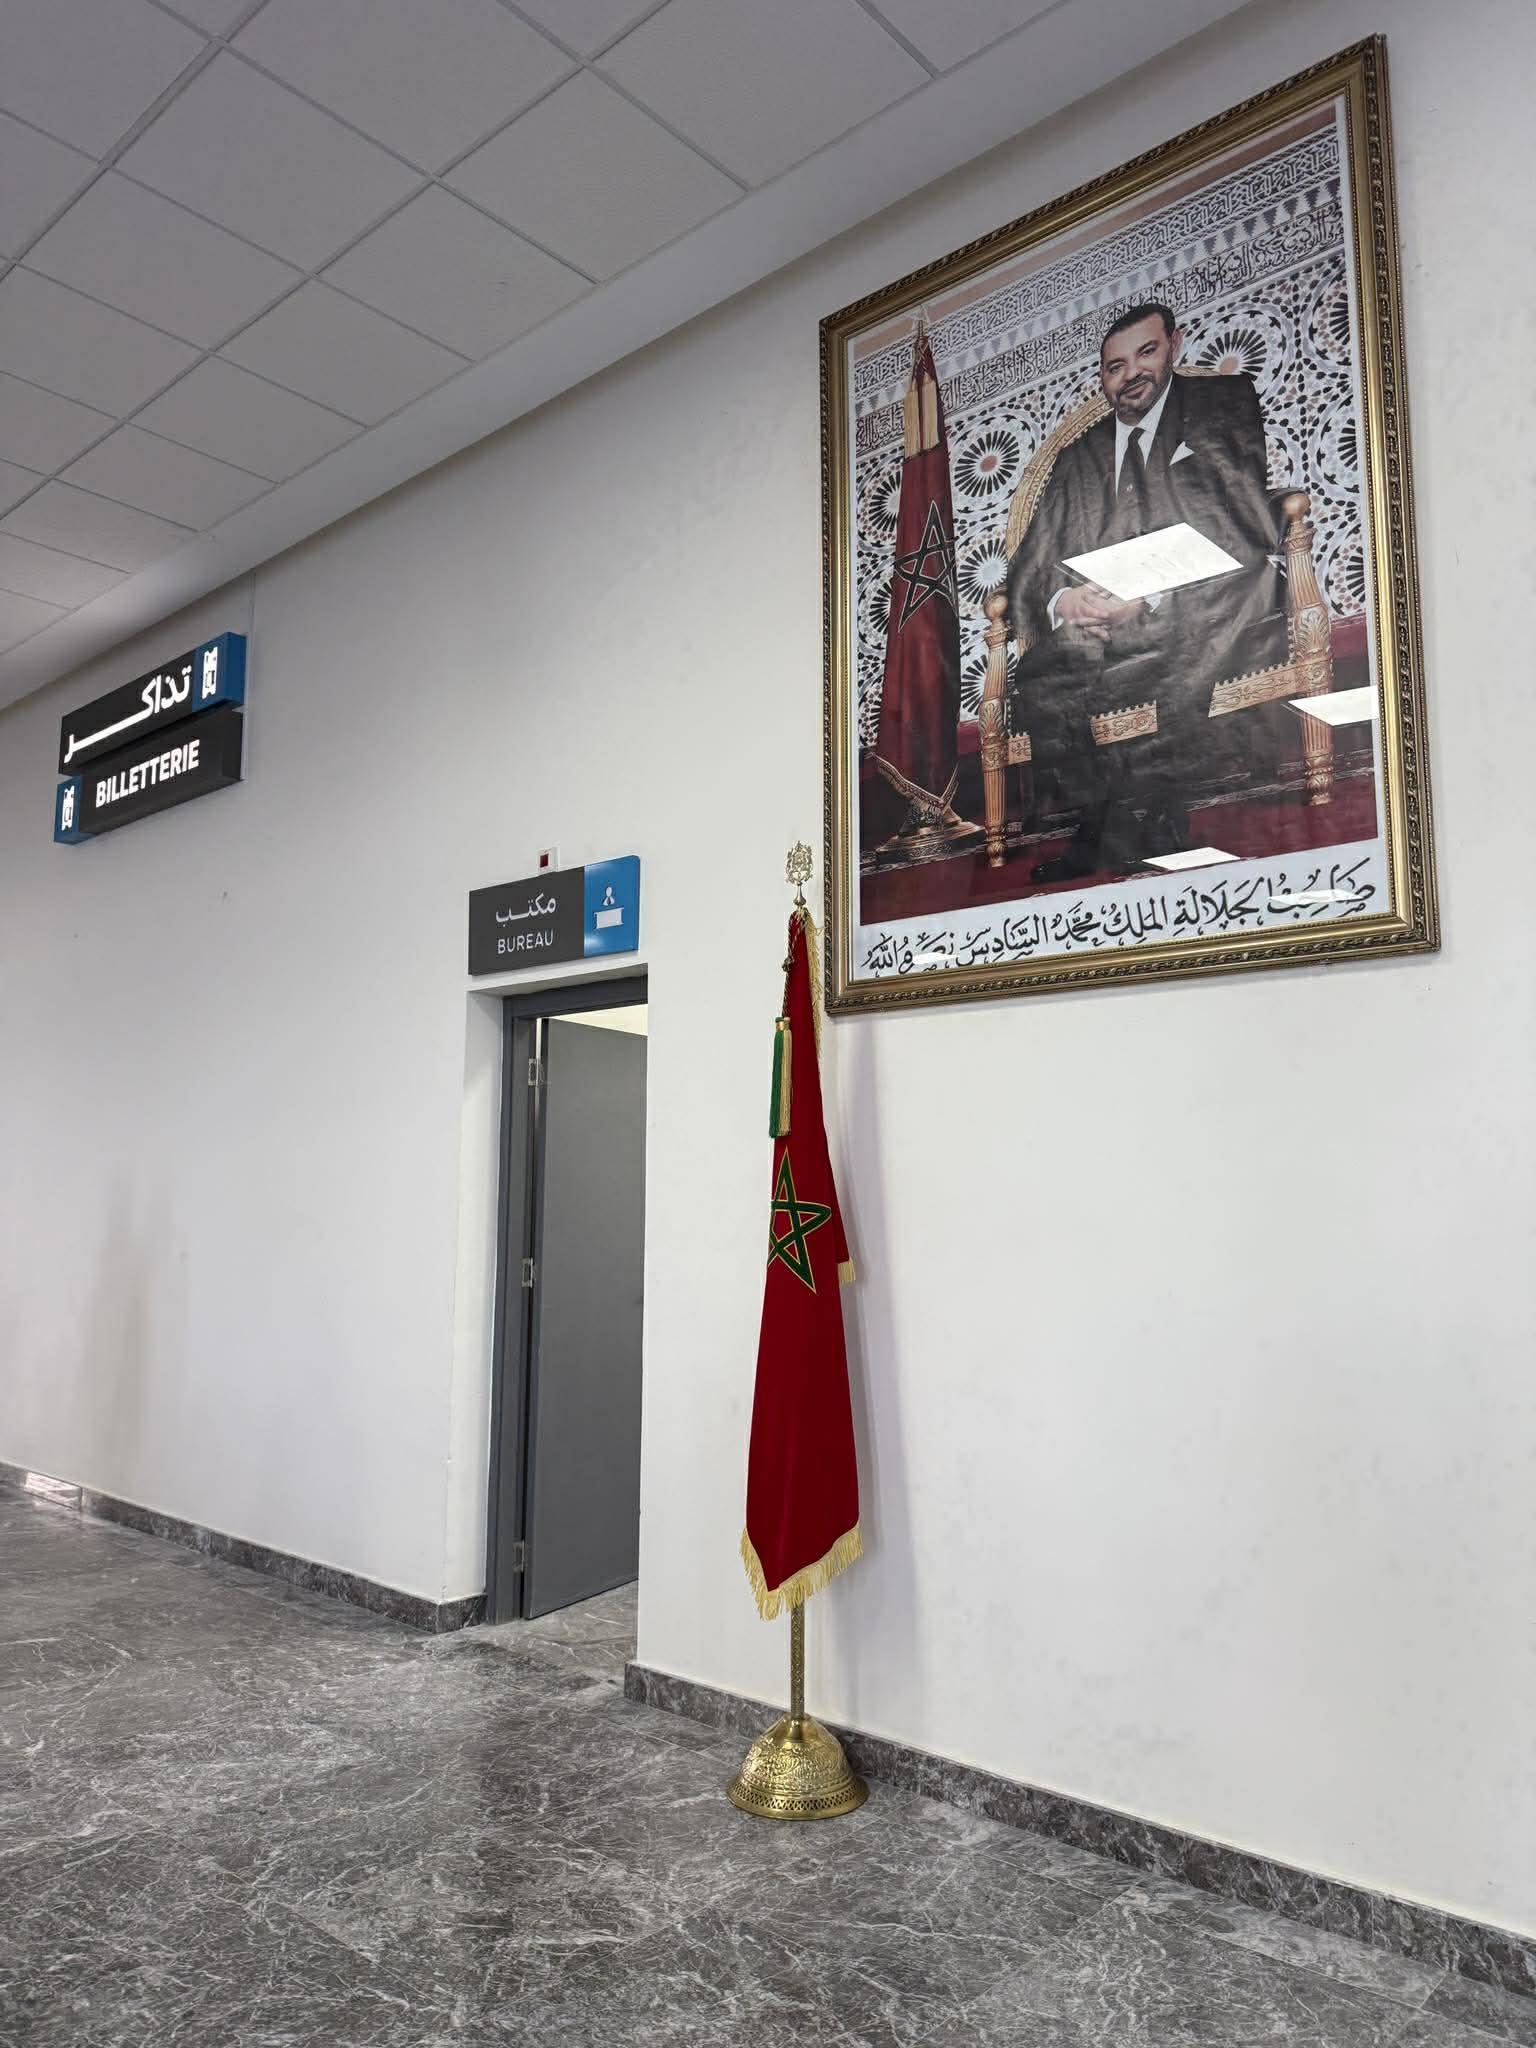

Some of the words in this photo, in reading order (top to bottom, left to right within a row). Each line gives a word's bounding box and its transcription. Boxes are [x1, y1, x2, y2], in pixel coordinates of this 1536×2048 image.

[64, 665, 191, 763] تذاكر
[96, 739, 200, 808] BILLETTERIE
[495, 893, 557, 927] مكتب
[497, 929, 554, 954] BUREAU
